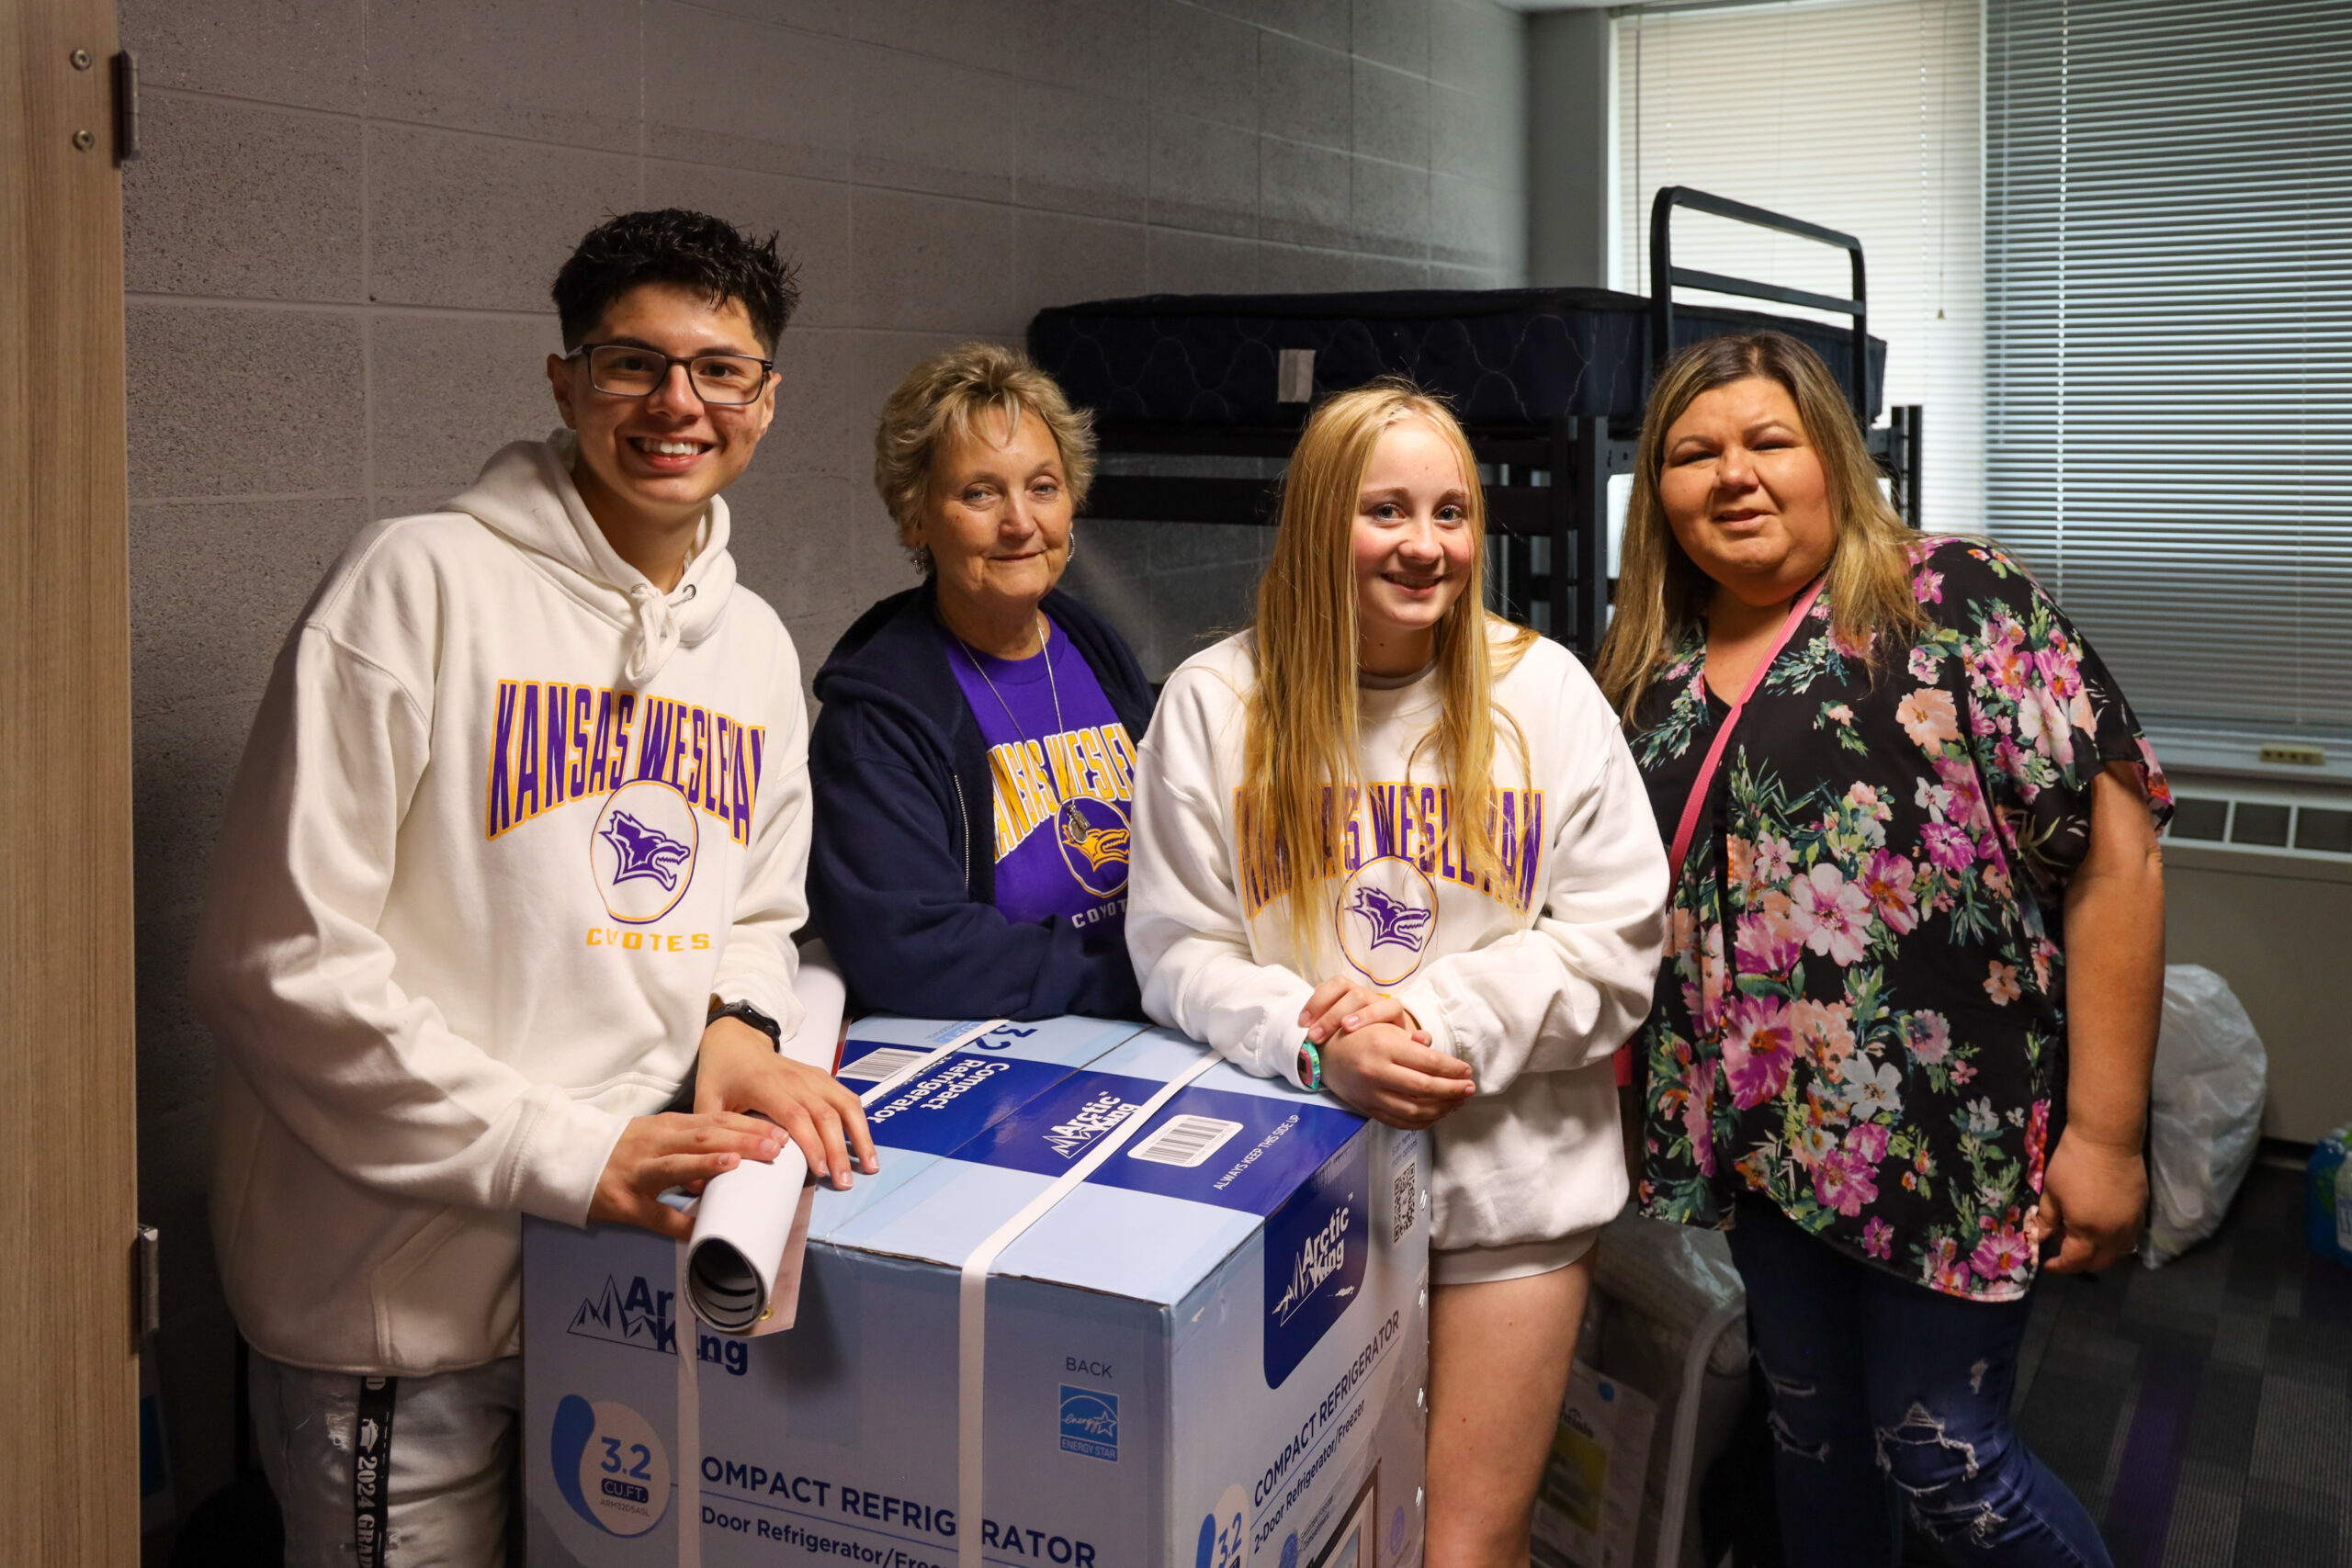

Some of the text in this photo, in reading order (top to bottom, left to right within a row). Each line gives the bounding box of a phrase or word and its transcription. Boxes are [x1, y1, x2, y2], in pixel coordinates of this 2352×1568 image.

[577, 679, 766, 851] KANSAS WESLEAN
[987, 739, 1057, 864] ANSAS
[1071, 898, 1129, 929] COYOT
[866, 1058, 987, 1123] Refrigerator
[921, 1062, 1011, 1111] Compact
[1050, 1093, 1121, 1137] Arctic
[1082, 1102, 1141, 1132] King
[1213, 1114, 1301, 1190] ALWAYS KEEP THIS SIDE UP
[1301, 1205, 1350, 1274] Arctic
[1312, 1235, 1345, 1289] King
[656, 1317, 748, 1376] Kng
[1066, 1356, 1113, 1379] BACK
[1254, 1309, 1400, 1509] COMPACT REFRIGERATOR
[600, 1436, 651, 1482] 3.2
[1061, 1438, 1116, 1460] ENERGY STAR
[356, 1455, 379, 1509] 2024
[1253, 1502, 1285, 1555] 2-Door
[1286, 1398, 1366, 1508] Refrigerator/Freezer
[701, 1456, 1096, 1568] OMPACT REFRIGRATOR
[701, 1506, 752, 1537] Door
